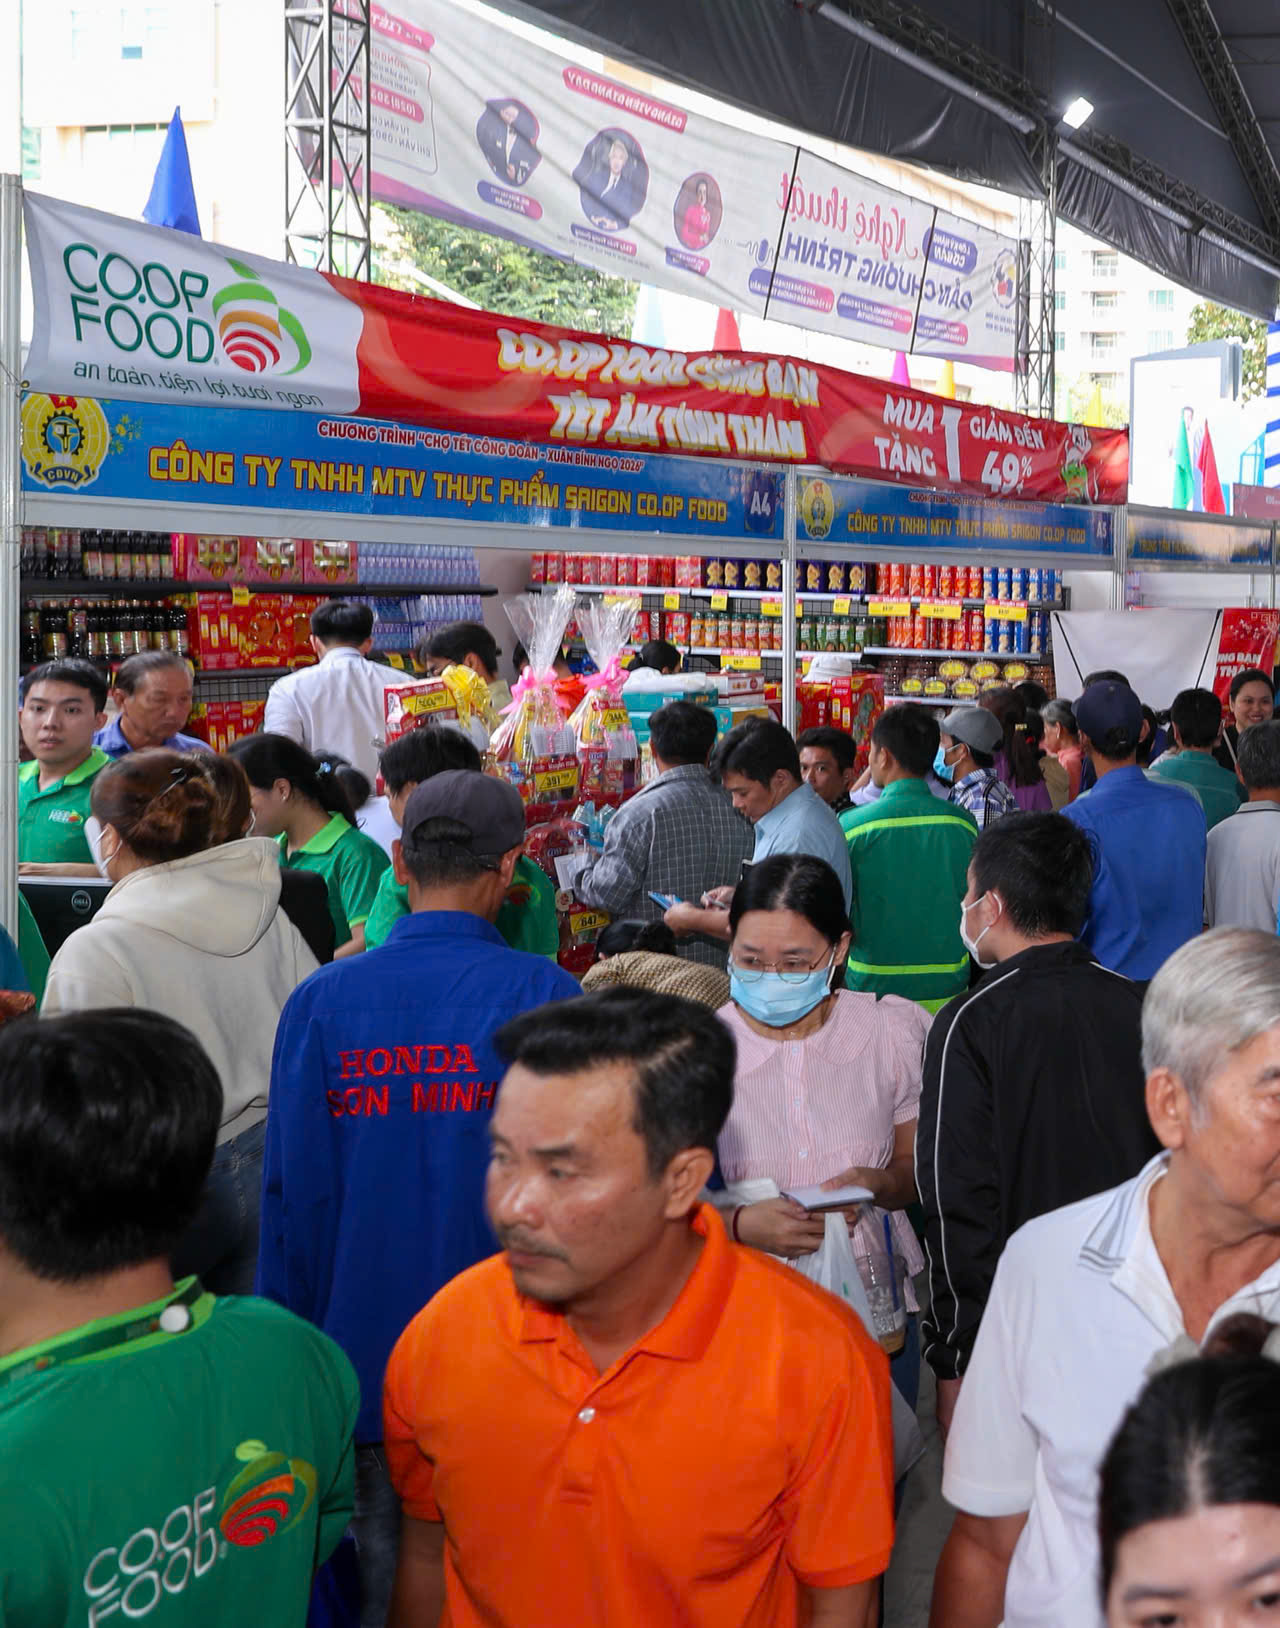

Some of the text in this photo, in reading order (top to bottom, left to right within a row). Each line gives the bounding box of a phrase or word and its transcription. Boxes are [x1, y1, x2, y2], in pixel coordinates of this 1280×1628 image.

[71, 294, 216, 364] FOOD
[74, 361, 100, 380] an
[277, 391, 323, 408] ngon
[883, 393, 934, 434] MUA
[969, 411, 1045, 450] GIẢM ĐẾN
[318, 421, 377, 441] CHƯƠNG
[379, 424, 415, 445] TRÌNH
[453, 435, 473, 451] TẾT
[474, 437, 505, 456] CÔNG
[508, 441, 538, 460] ĐOÀN
[547, 447, 573, 463] XUÂN
[575, 450, 597, 468] BÍNH
[598, 456, 618, 475] NGỌ
[874, 432, 937, 480] TẶNG
[940, 405, 963, 483] 1
[149, 439, 728, 523] CÔNG TY TNHH MTV THỰC PHẨM SAIGON CO.OP FOOD
[750, 491, 771, 516] A4
[847, 508, 878, 533] CÔNG
[881, 514, 896, 533] TY
[899, 515, 928, 535] TNHH
[930, 517, 952, 536] MTV
[1067, 528, 1086, 544] FOOD
[338, 1044, 479, 1079] HONDA
[411, 1081, 498, 1112] MINH
[88, 1527, 217, 1628] FOOD
